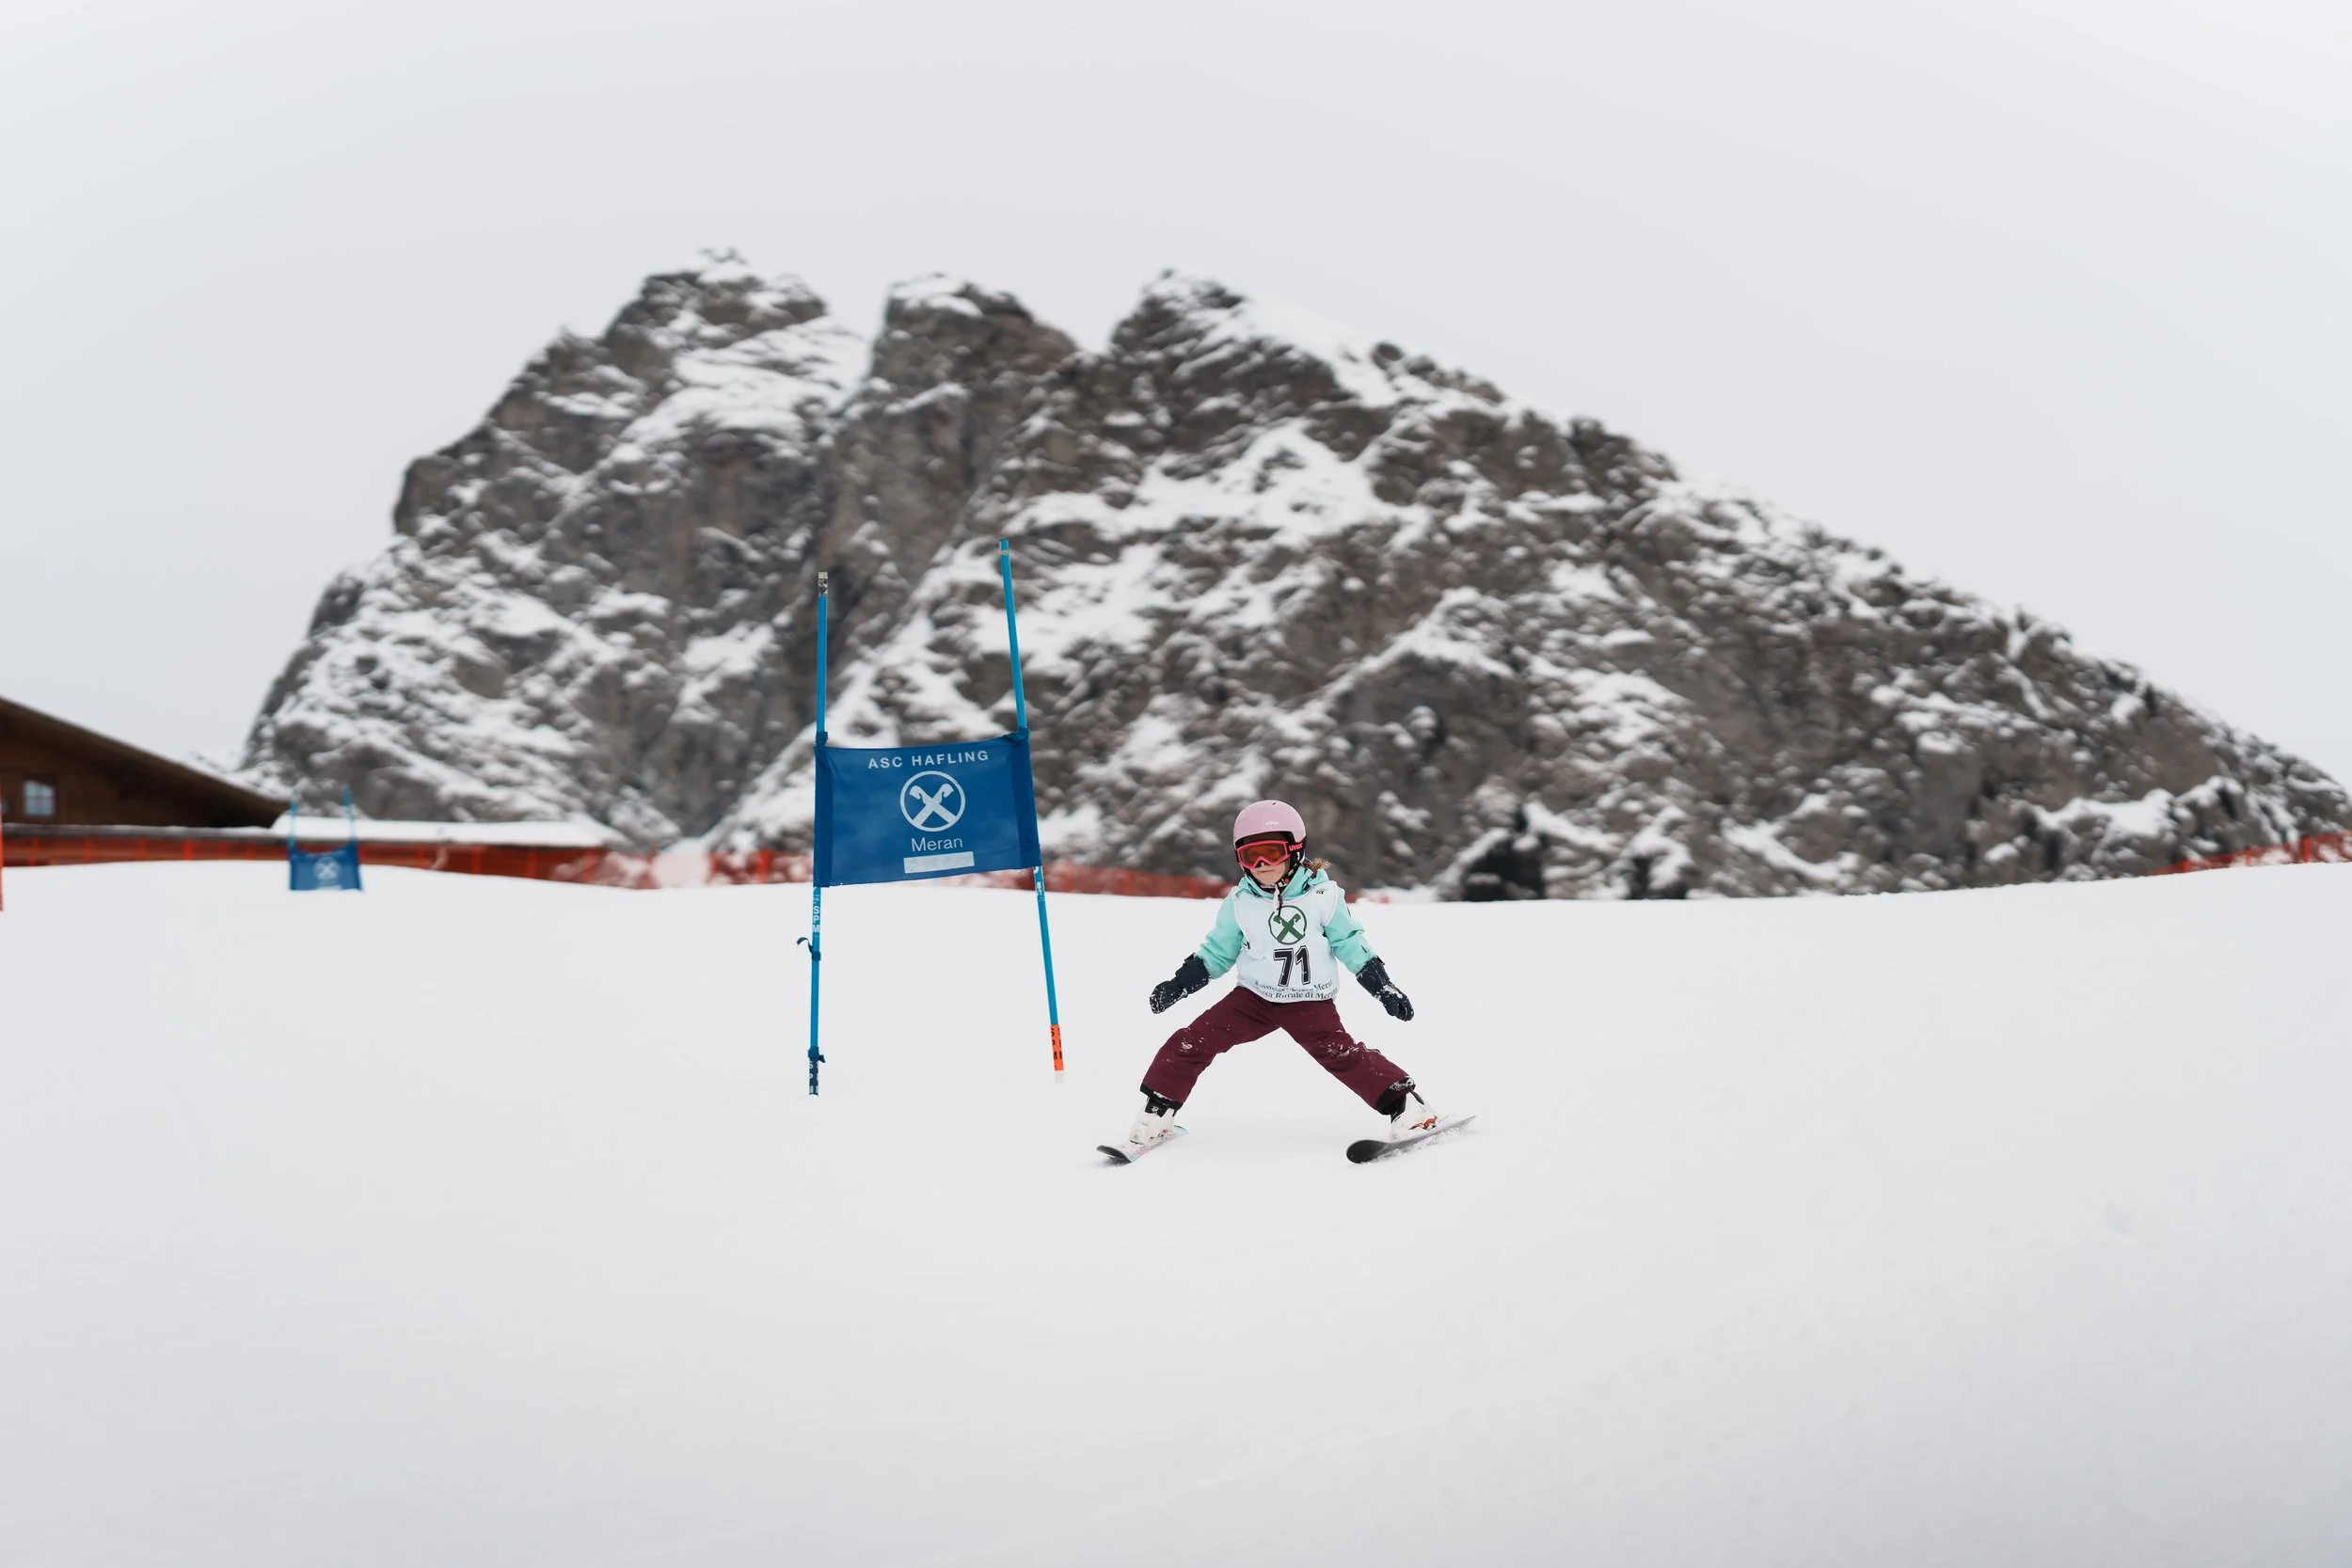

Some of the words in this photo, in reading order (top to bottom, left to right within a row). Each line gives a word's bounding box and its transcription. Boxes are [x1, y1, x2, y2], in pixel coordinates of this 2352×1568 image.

[867, 756, 903, 769] ASC
[912, 751, 989, 767] HAFLING
[911, 837, 963, 852] Meran
[1273, 944, 1311, 988] 71
[1305, 990, 1314, 999] di
[1315, 988, 1339, 1000] Meran
